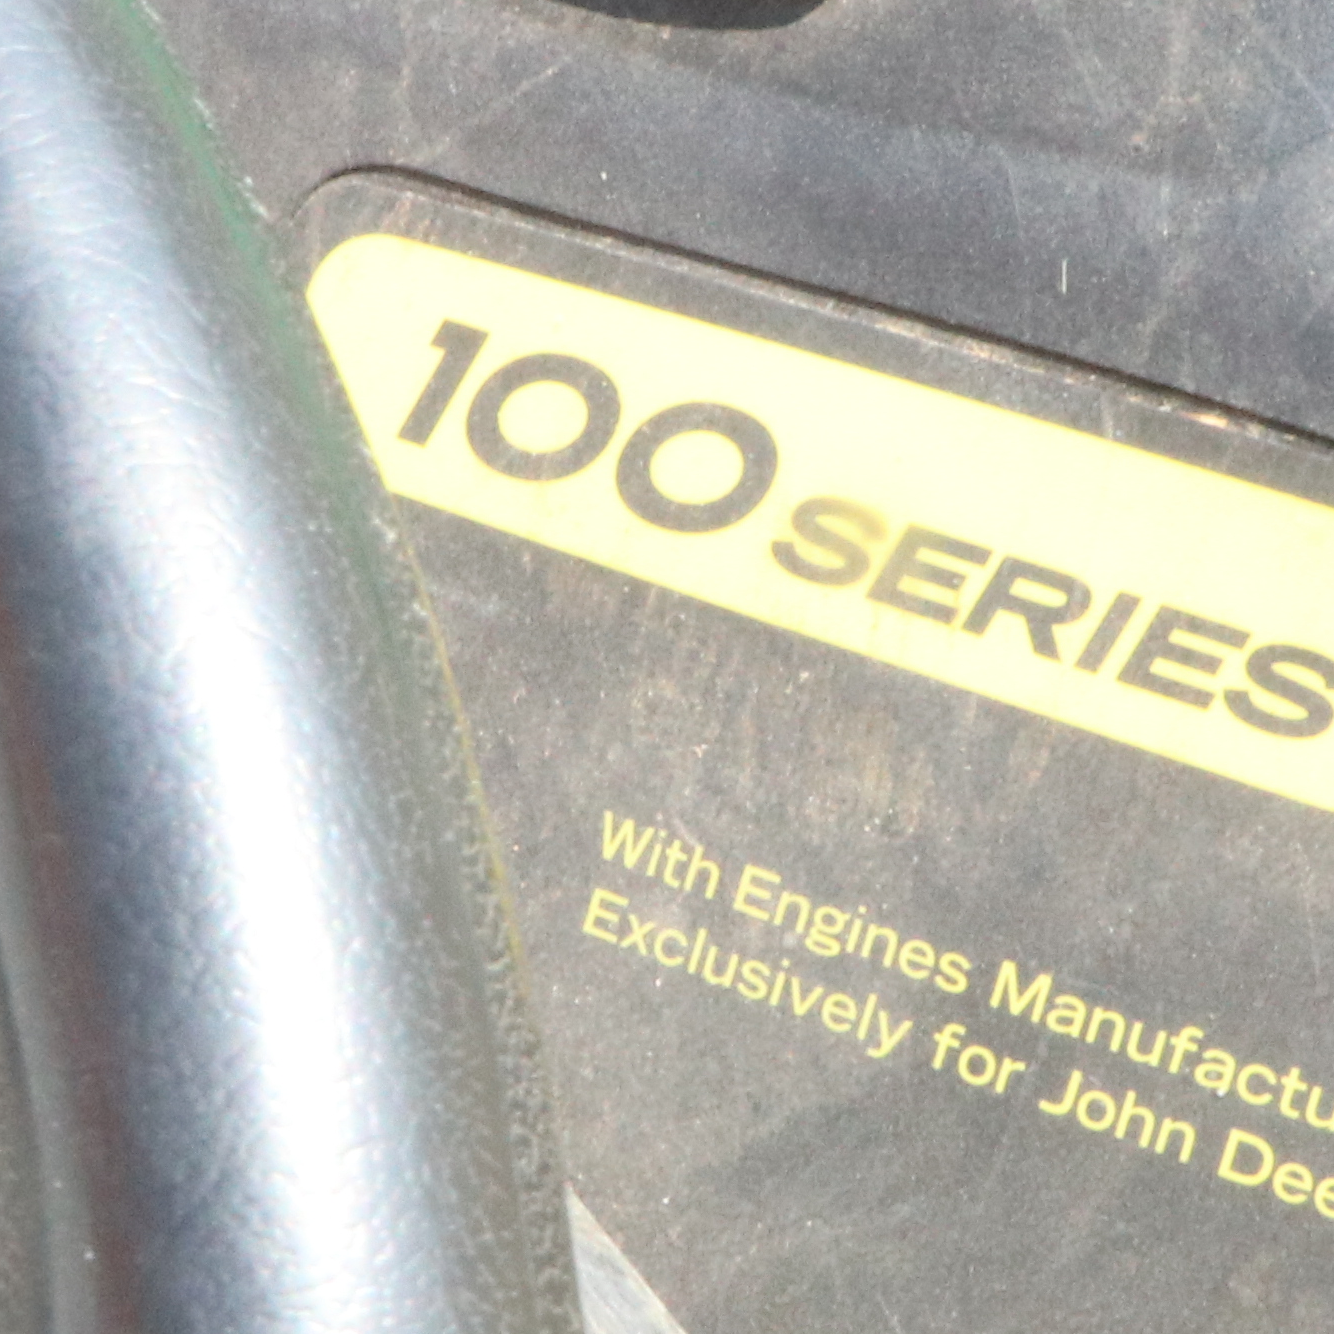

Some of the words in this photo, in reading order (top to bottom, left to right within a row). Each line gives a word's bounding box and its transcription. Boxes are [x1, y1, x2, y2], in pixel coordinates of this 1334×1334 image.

[399, 319, 778, 534] 100
[601, 812, 722, 899] With
[733, 864, 972, 994] Engines
[582, 888, 913, 1059] Exclusively
[932, 1023, 1027, 1094] for
[1039, 1070, 1198, 1164] John
